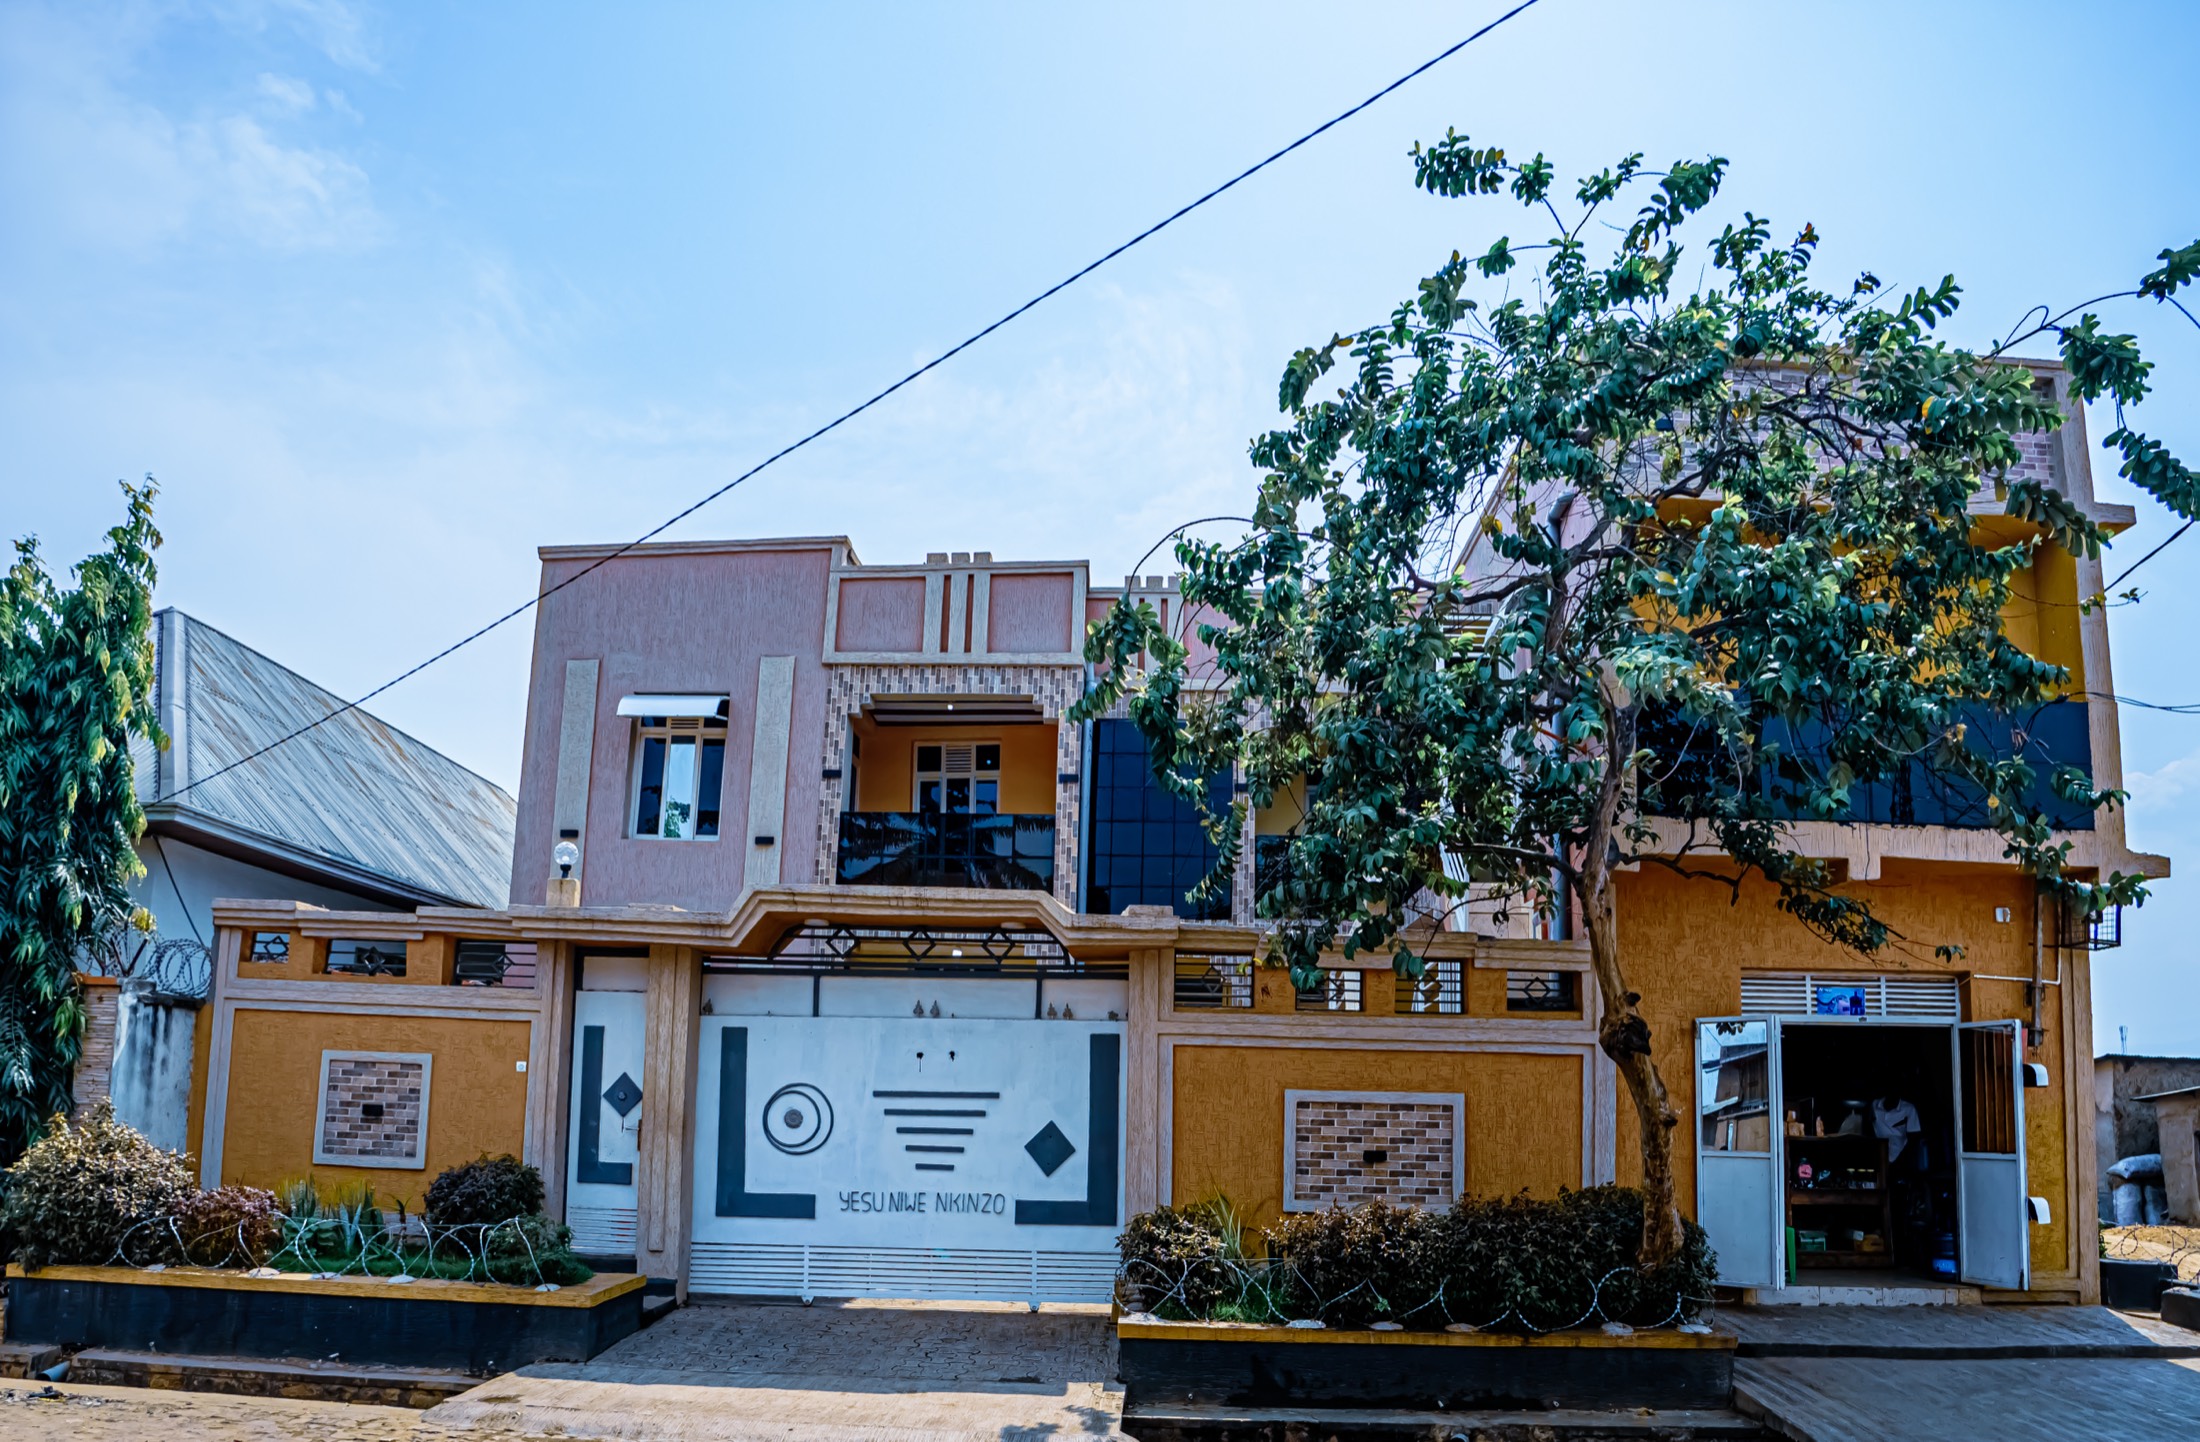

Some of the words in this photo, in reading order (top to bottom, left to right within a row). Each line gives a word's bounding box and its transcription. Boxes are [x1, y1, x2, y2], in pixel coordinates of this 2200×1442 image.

[839, 1191, 884, 1213] YESU
[888, 1191, 927, 1213] NIWE
[935, 1192, 1006, 1215] NKINZO
